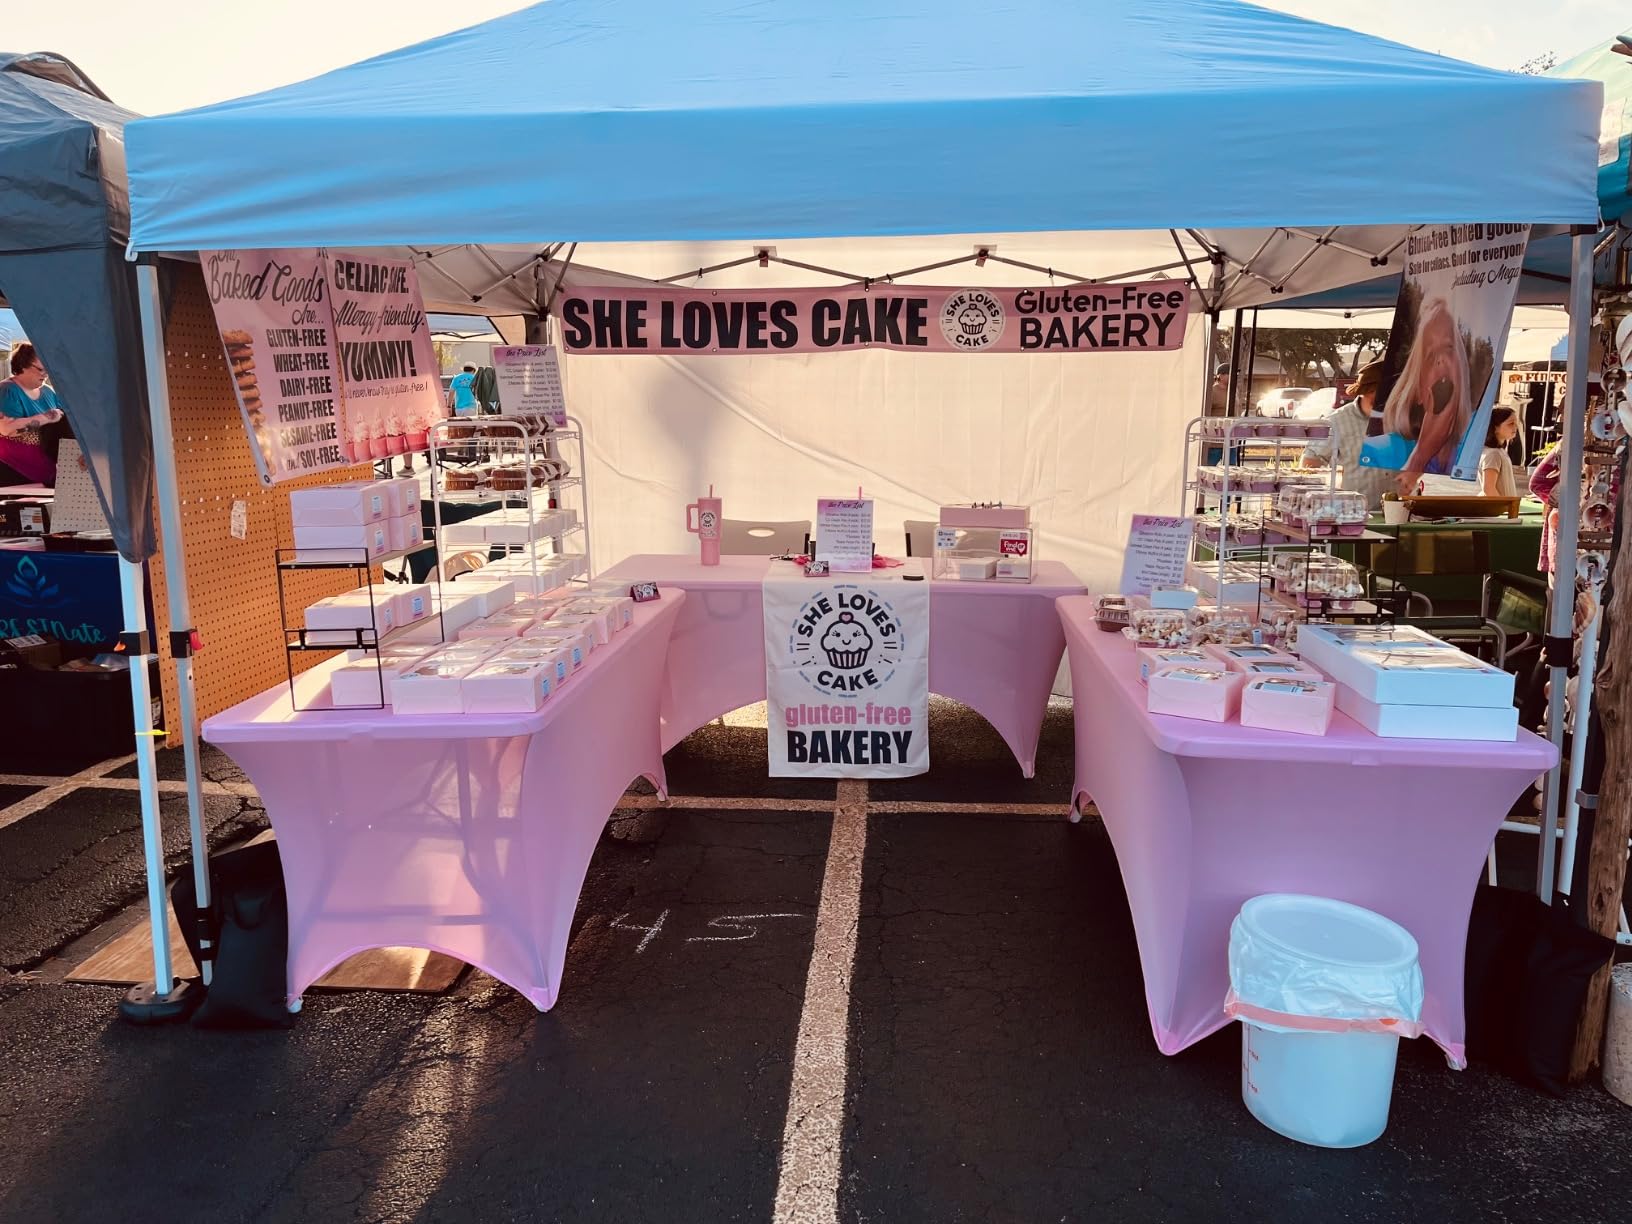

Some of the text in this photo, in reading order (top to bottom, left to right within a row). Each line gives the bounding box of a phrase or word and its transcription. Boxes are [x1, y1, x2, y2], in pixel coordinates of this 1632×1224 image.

[208, 255, 325, 306] Baked Goods
[334, 259, 388, 294] CELIAC
[946, 293, 1000, 318] SHE LOVES
[1014, 286, 1184, 315] Gluten-Free
[562, 297, 928, 349] SHE LOVES CAKE
[1020, 312, 1176, 349] BAKERY
[267, 329, 327, 348] GLUTEN-FREE
[955, 334, 989, 347] CAKE
[273, 353, 330, 373] WHEAT-FREE
[339, 340, 417, 382] YUMMY!
[280, 376, 333, 397] DAIRY-FREE
[278, 400, 335, 423] PEANUT-FREE
[280, 422, 337, 448] SESAME-FREE
[797, 592, 896, 638] SHE LOVES
[817, 668, 879, 691] CAKE
[785, 702, 912, 728] gluten-free
[787, 730, 913, 765] BAKERY
